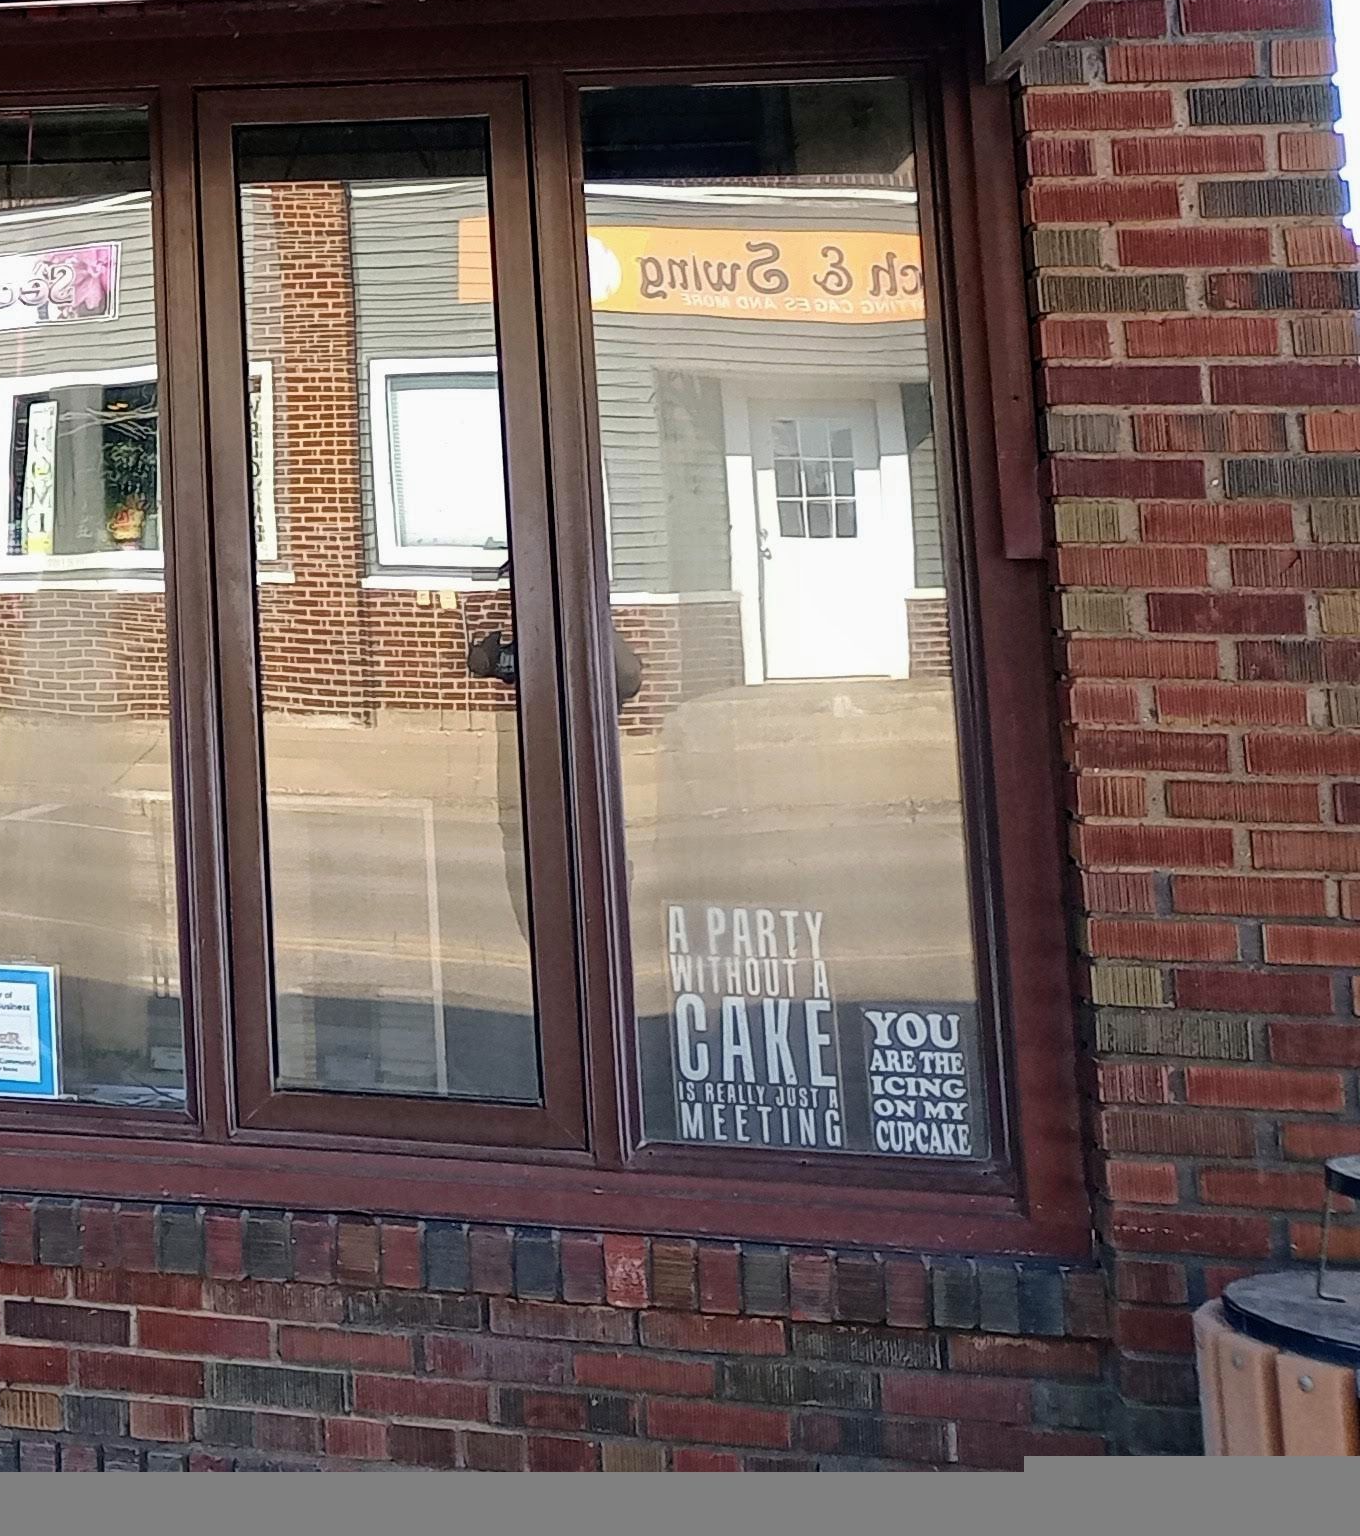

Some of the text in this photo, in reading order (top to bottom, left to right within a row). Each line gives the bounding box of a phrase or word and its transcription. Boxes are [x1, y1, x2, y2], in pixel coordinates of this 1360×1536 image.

[668, 905, 824, 960] A PARTY
[669, 954, 829, 998] WITHOUT A
[675, 993, 837, 1087] CAKE
[863, 1010, 961, 1049] YOU
[868, 1048, 966, 1076] ARE THE
[678, 1081, 838, 1109] IS REALLY JUST A
[870, 1075, 968, 1100] ICING
[680, 1101, 843, 1148] MEETING
[873, 1098, 969, 1120] ON MY
[875, 1119, 972, 1156] CUPCAKE
